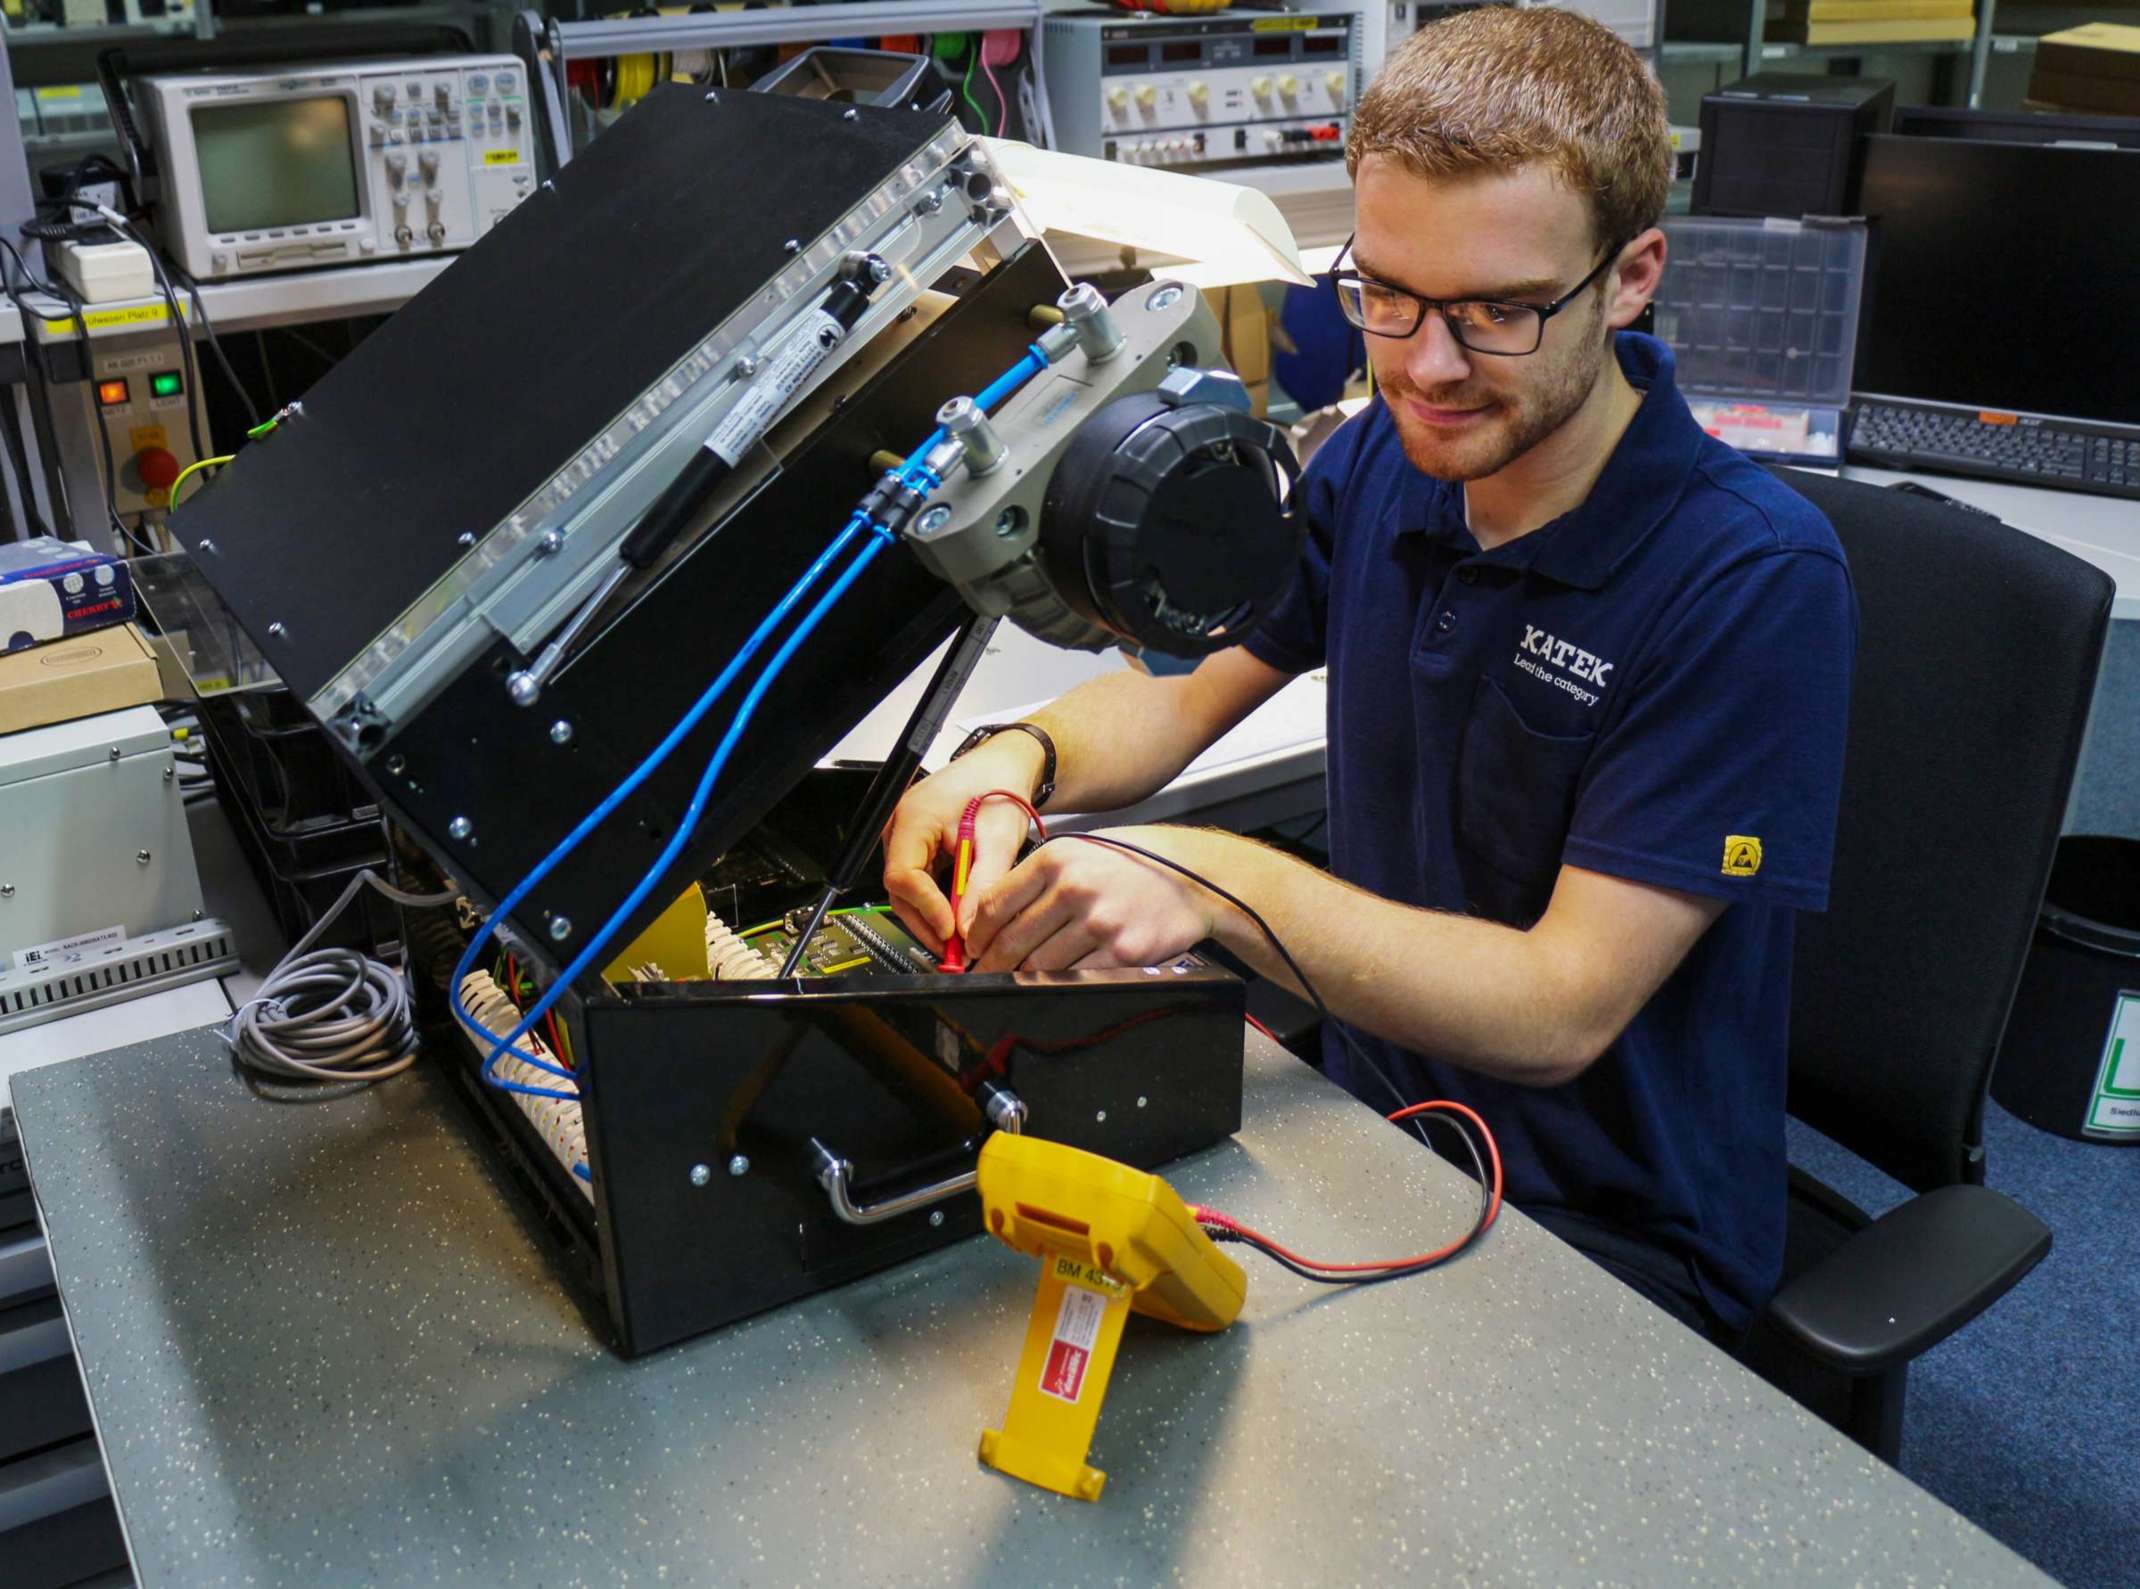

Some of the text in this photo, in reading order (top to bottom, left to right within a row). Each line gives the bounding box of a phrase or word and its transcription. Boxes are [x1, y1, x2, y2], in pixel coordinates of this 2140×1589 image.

[67, 601, 110, 619] CHERRY
[1520, 624, 1614, 687] KATEK
[1513, 653, 1600, 707] Lead the category
[1056, 1259, 1081, 1279] BM
